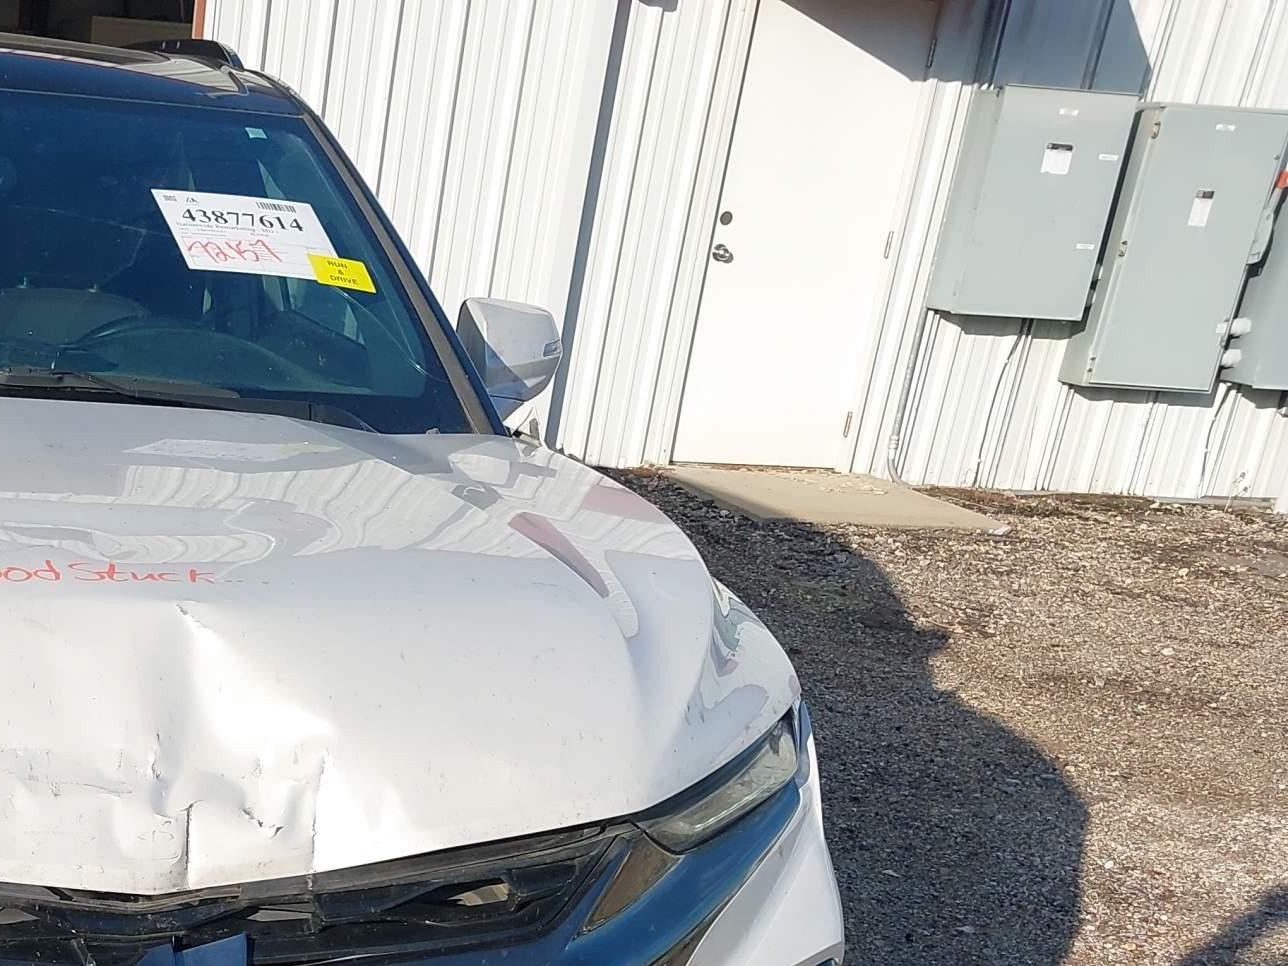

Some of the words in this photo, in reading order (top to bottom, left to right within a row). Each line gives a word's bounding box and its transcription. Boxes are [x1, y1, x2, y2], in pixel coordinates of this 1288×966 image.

[182, 208, 303, 231] 43877614
[327, 260, 348, 269] RUN
[329, 275, 359, 284] DRIVE
[67, 559, 215, 584] Stuck
